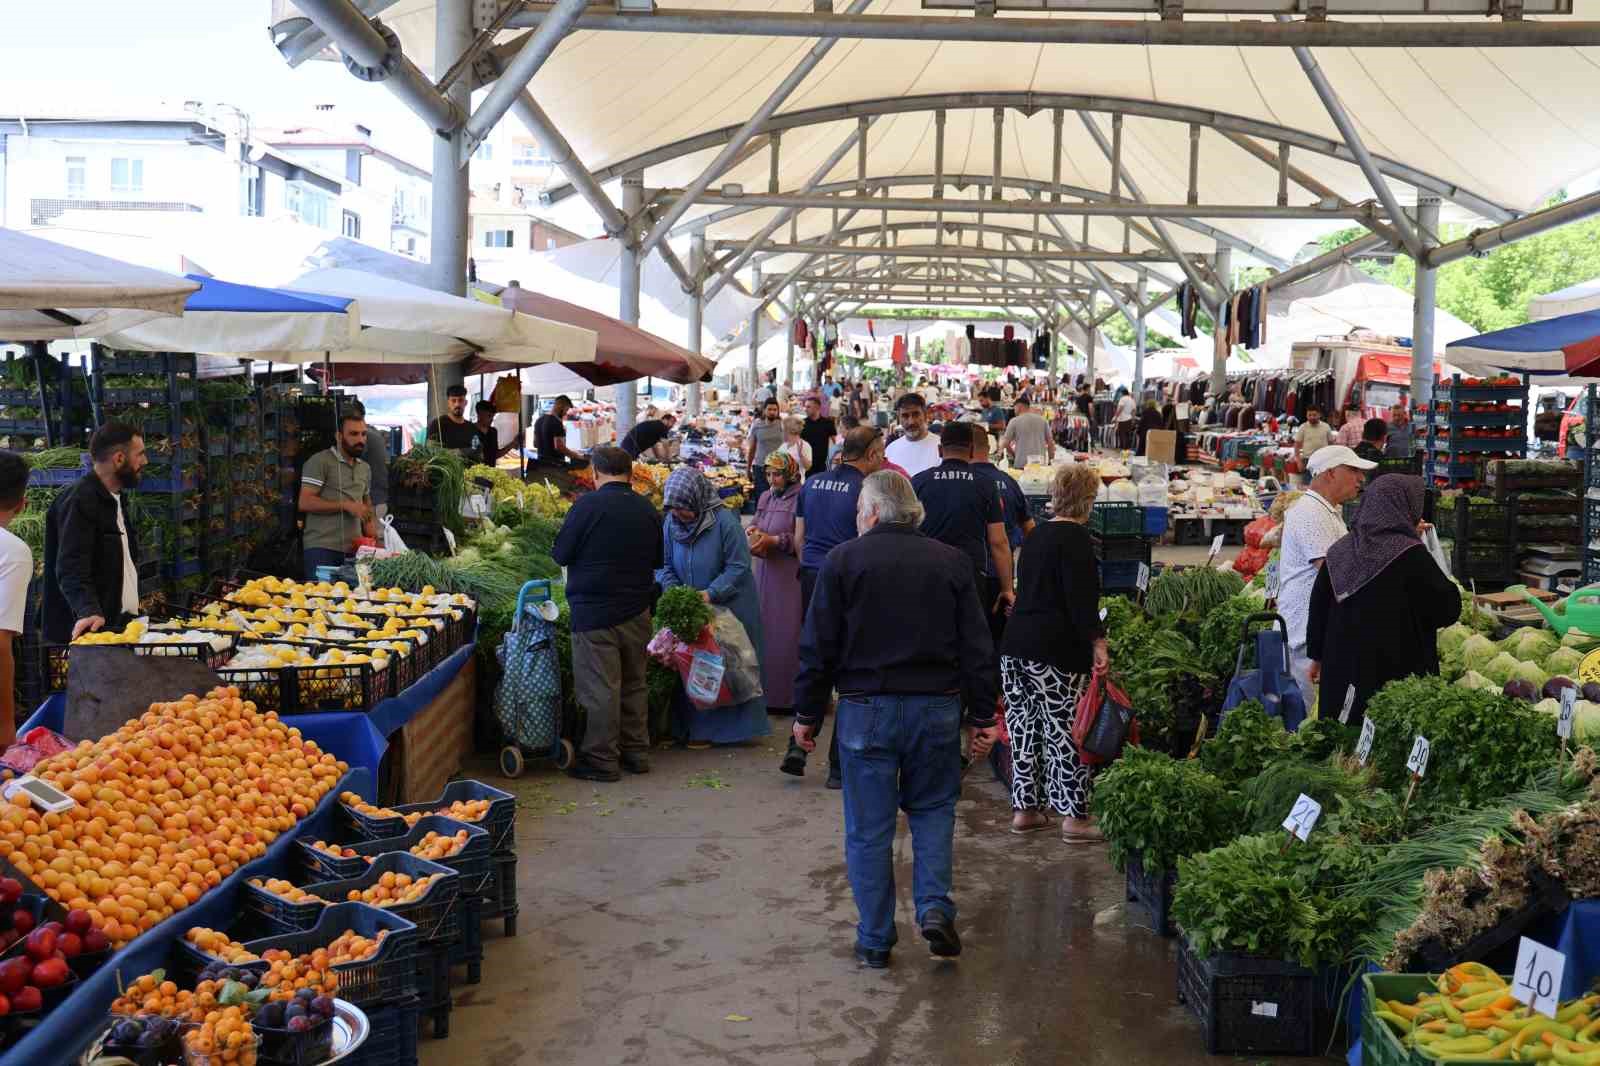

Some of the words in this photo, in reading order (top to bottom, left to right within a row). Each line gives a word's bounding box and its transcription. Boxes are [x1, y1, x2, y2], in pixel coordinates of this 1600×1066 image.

[811, 479, 849, 493] ZABITA
[934, 470, 974, 481] ZABITA
[1411, 739, 1428, 766] 20
[1292, 799, 1316, 830] 20
[1518, 949, 1553, 998] 10
